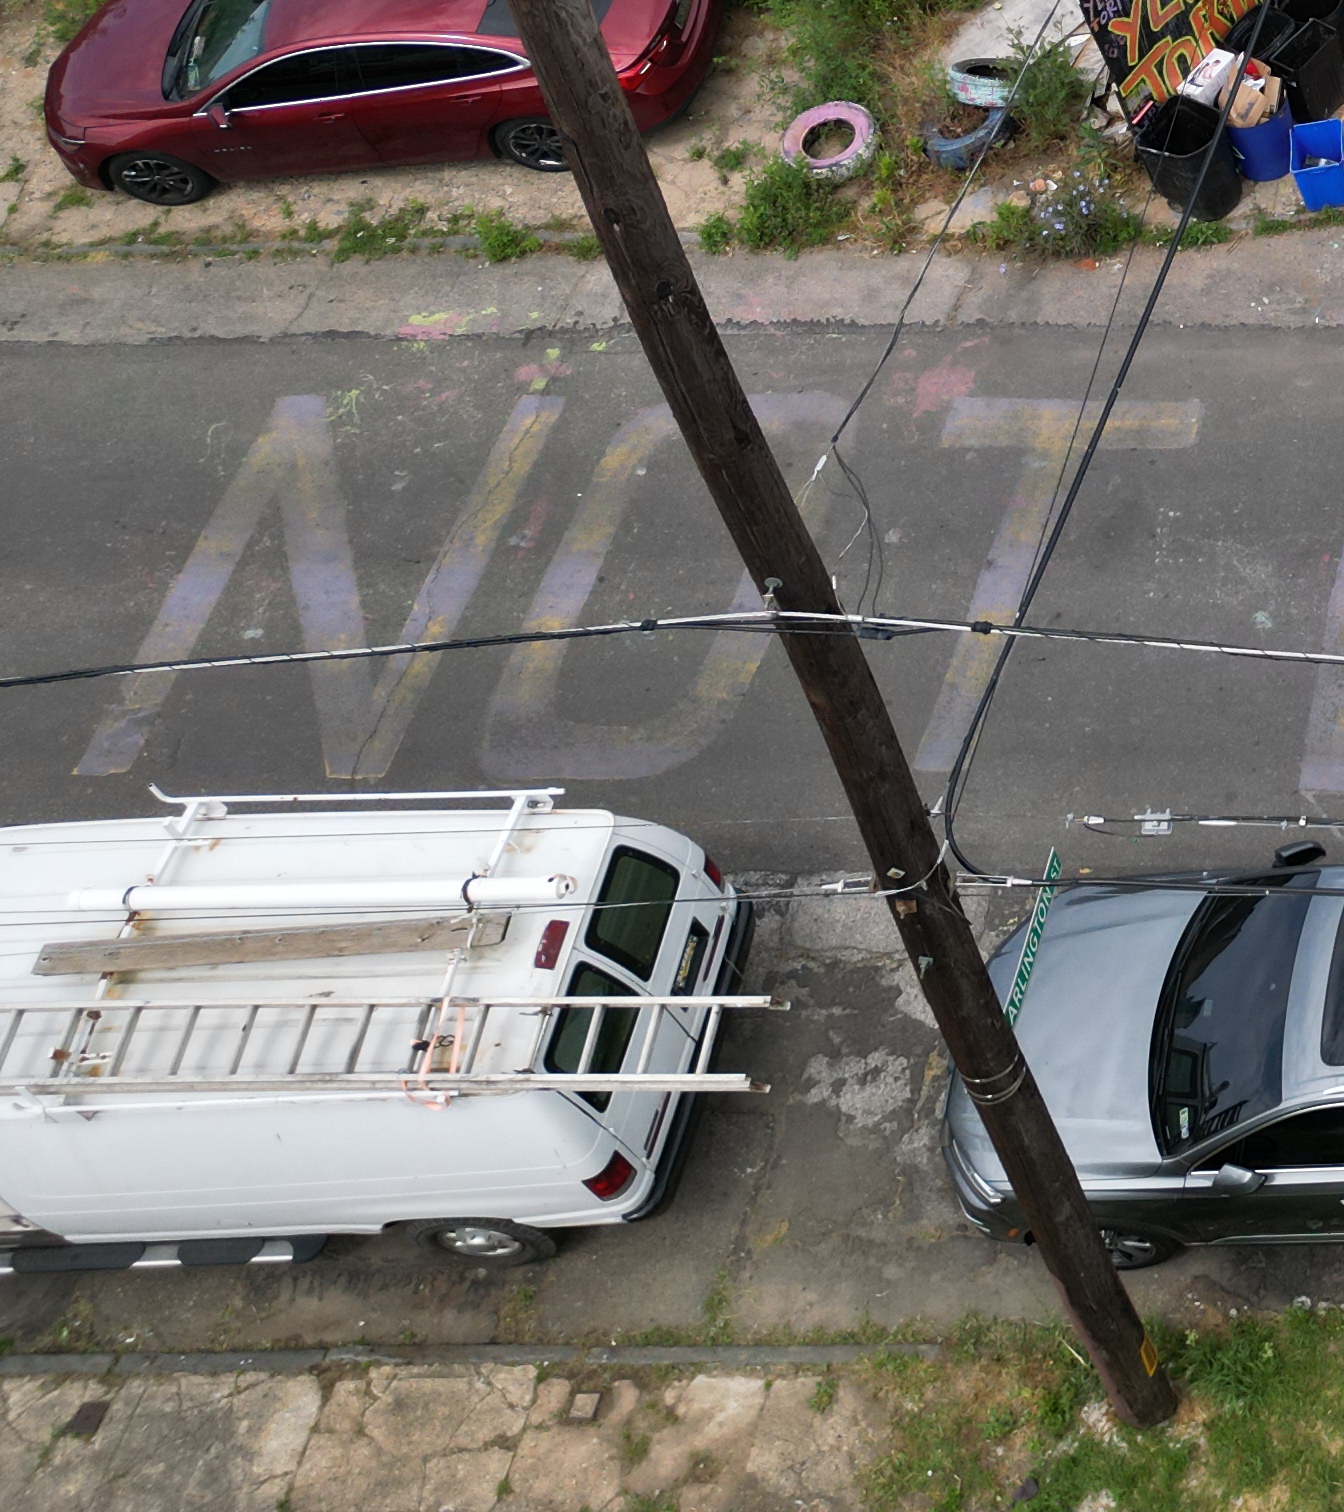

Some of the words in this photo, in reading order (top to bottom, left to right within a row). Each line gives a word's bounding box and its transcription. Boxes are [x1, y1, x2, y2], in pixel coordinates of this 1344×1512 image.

[73, 390, 1199, 782] NOT
[1007, 885, 1052, 1027] ARLINGTON
[1050, 857, 1059, 881] ST
